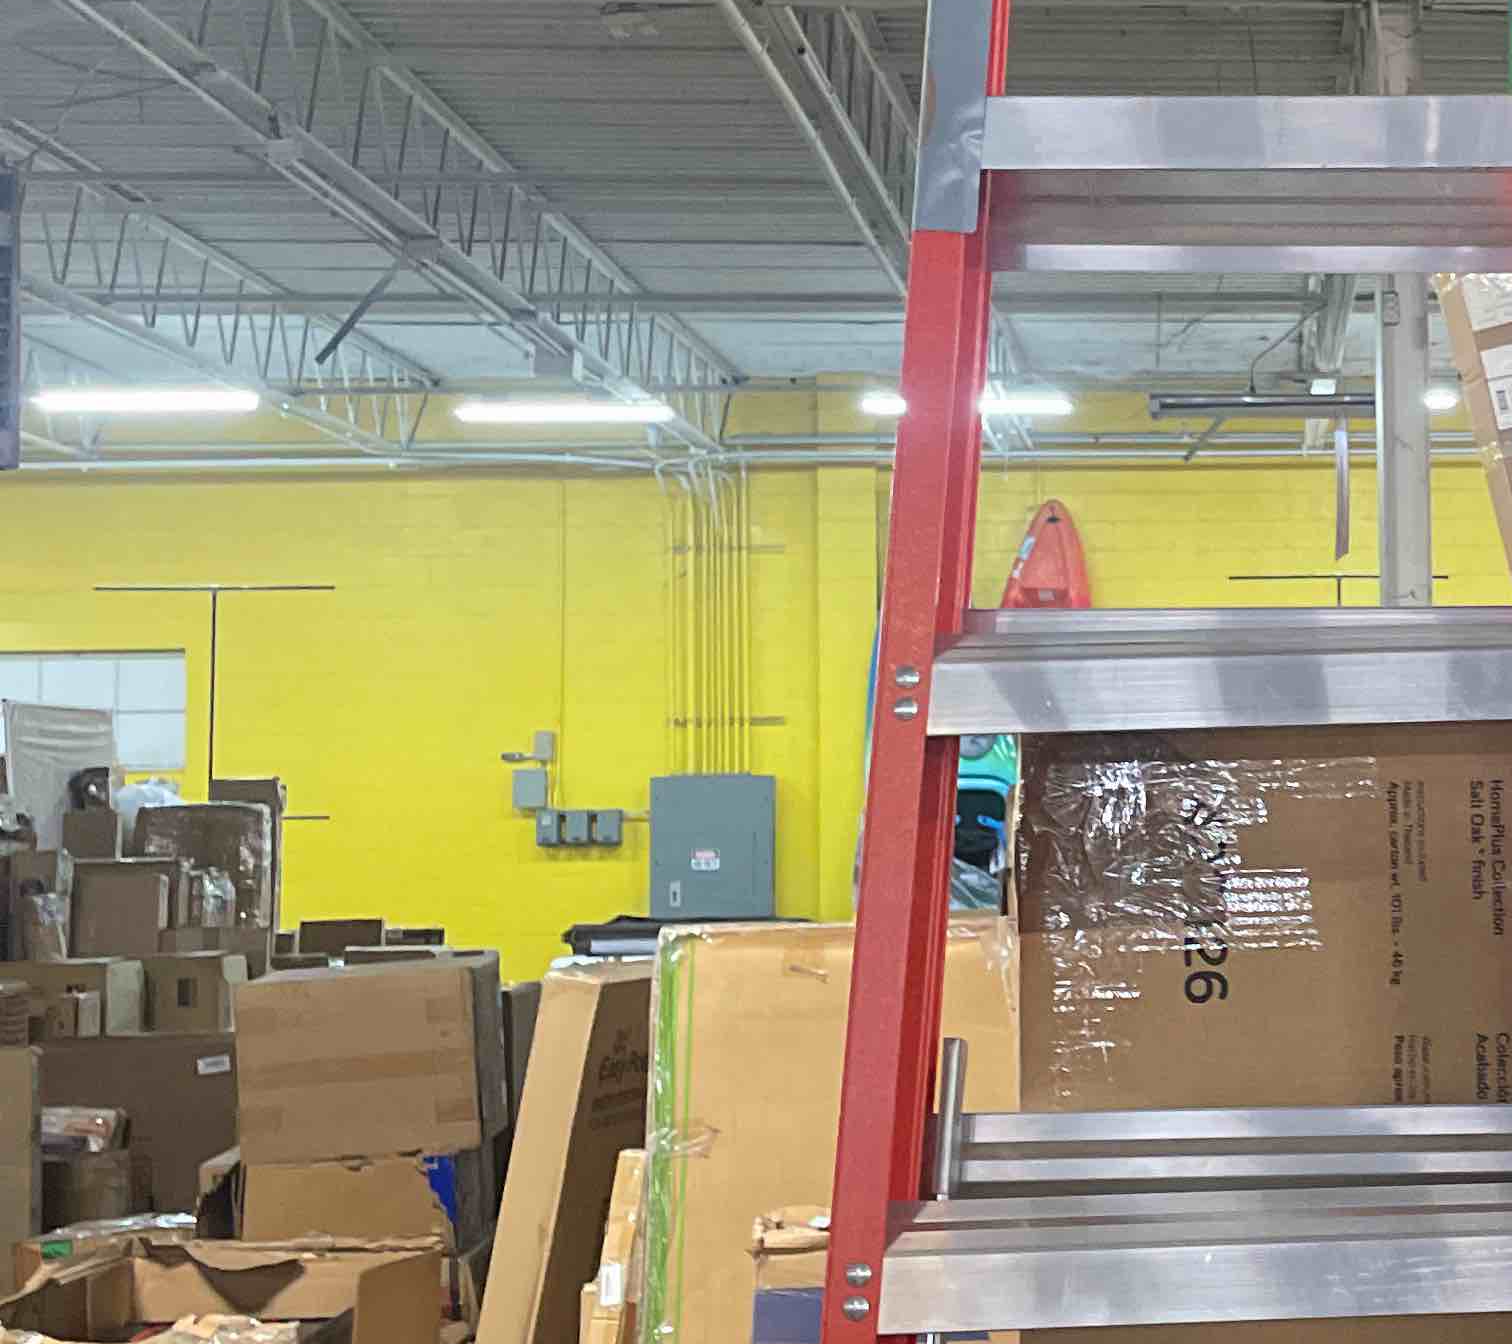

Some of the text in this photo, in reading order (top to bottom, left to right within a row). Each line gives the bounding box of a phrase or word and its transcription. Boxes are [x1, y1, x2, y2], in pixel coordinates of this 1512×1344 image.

[1470, 813, 1485, 843] Oak
[1391, 830, 1401, 870] carton
[1489, 779, 1506, 936] HomePlus Collection
[1472, 859, 1489, 900] finish
[1389, 970, 1402, 986] kg
